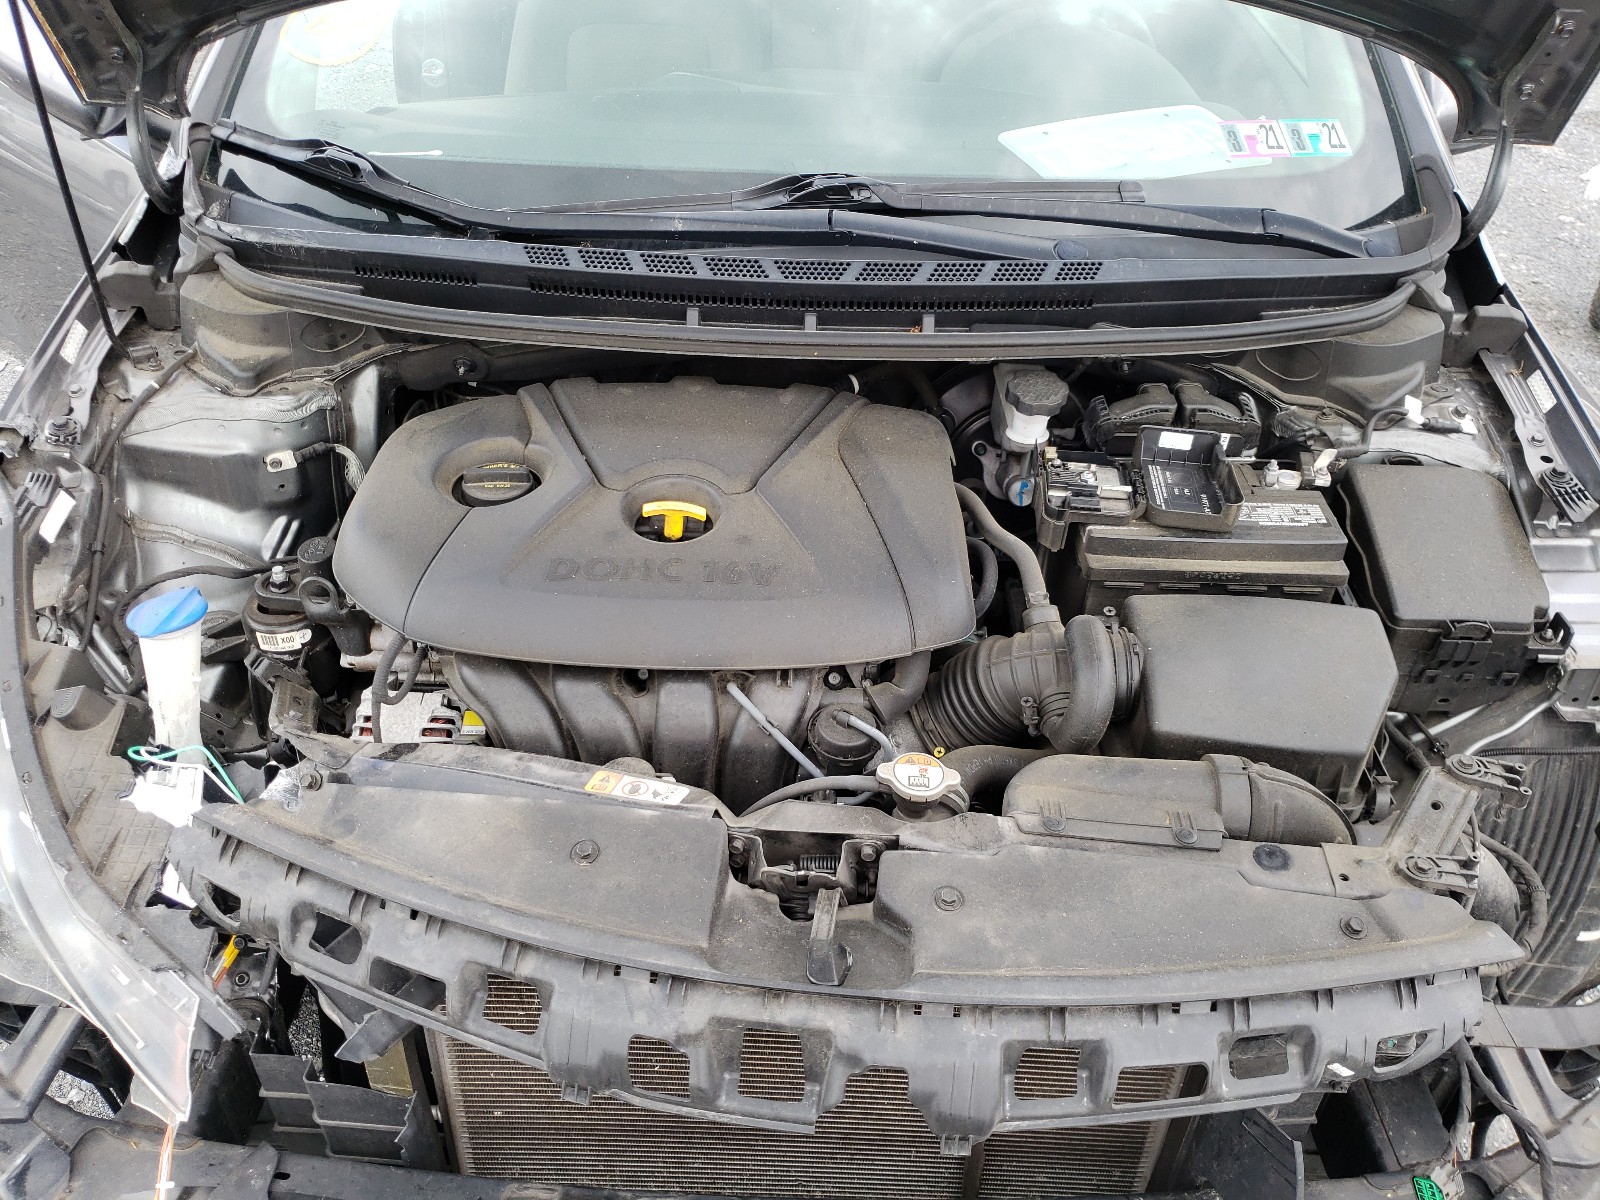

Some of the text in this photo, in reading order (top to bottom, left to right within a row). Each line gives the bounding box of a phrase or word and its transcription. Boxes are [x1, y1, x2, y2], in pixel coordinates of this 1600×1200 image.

[1226, 124, 1285, 153] 3 21
[1290, 122, 1347, 151] 3 21
[543, 557, 782, 586] DOHC 16V
